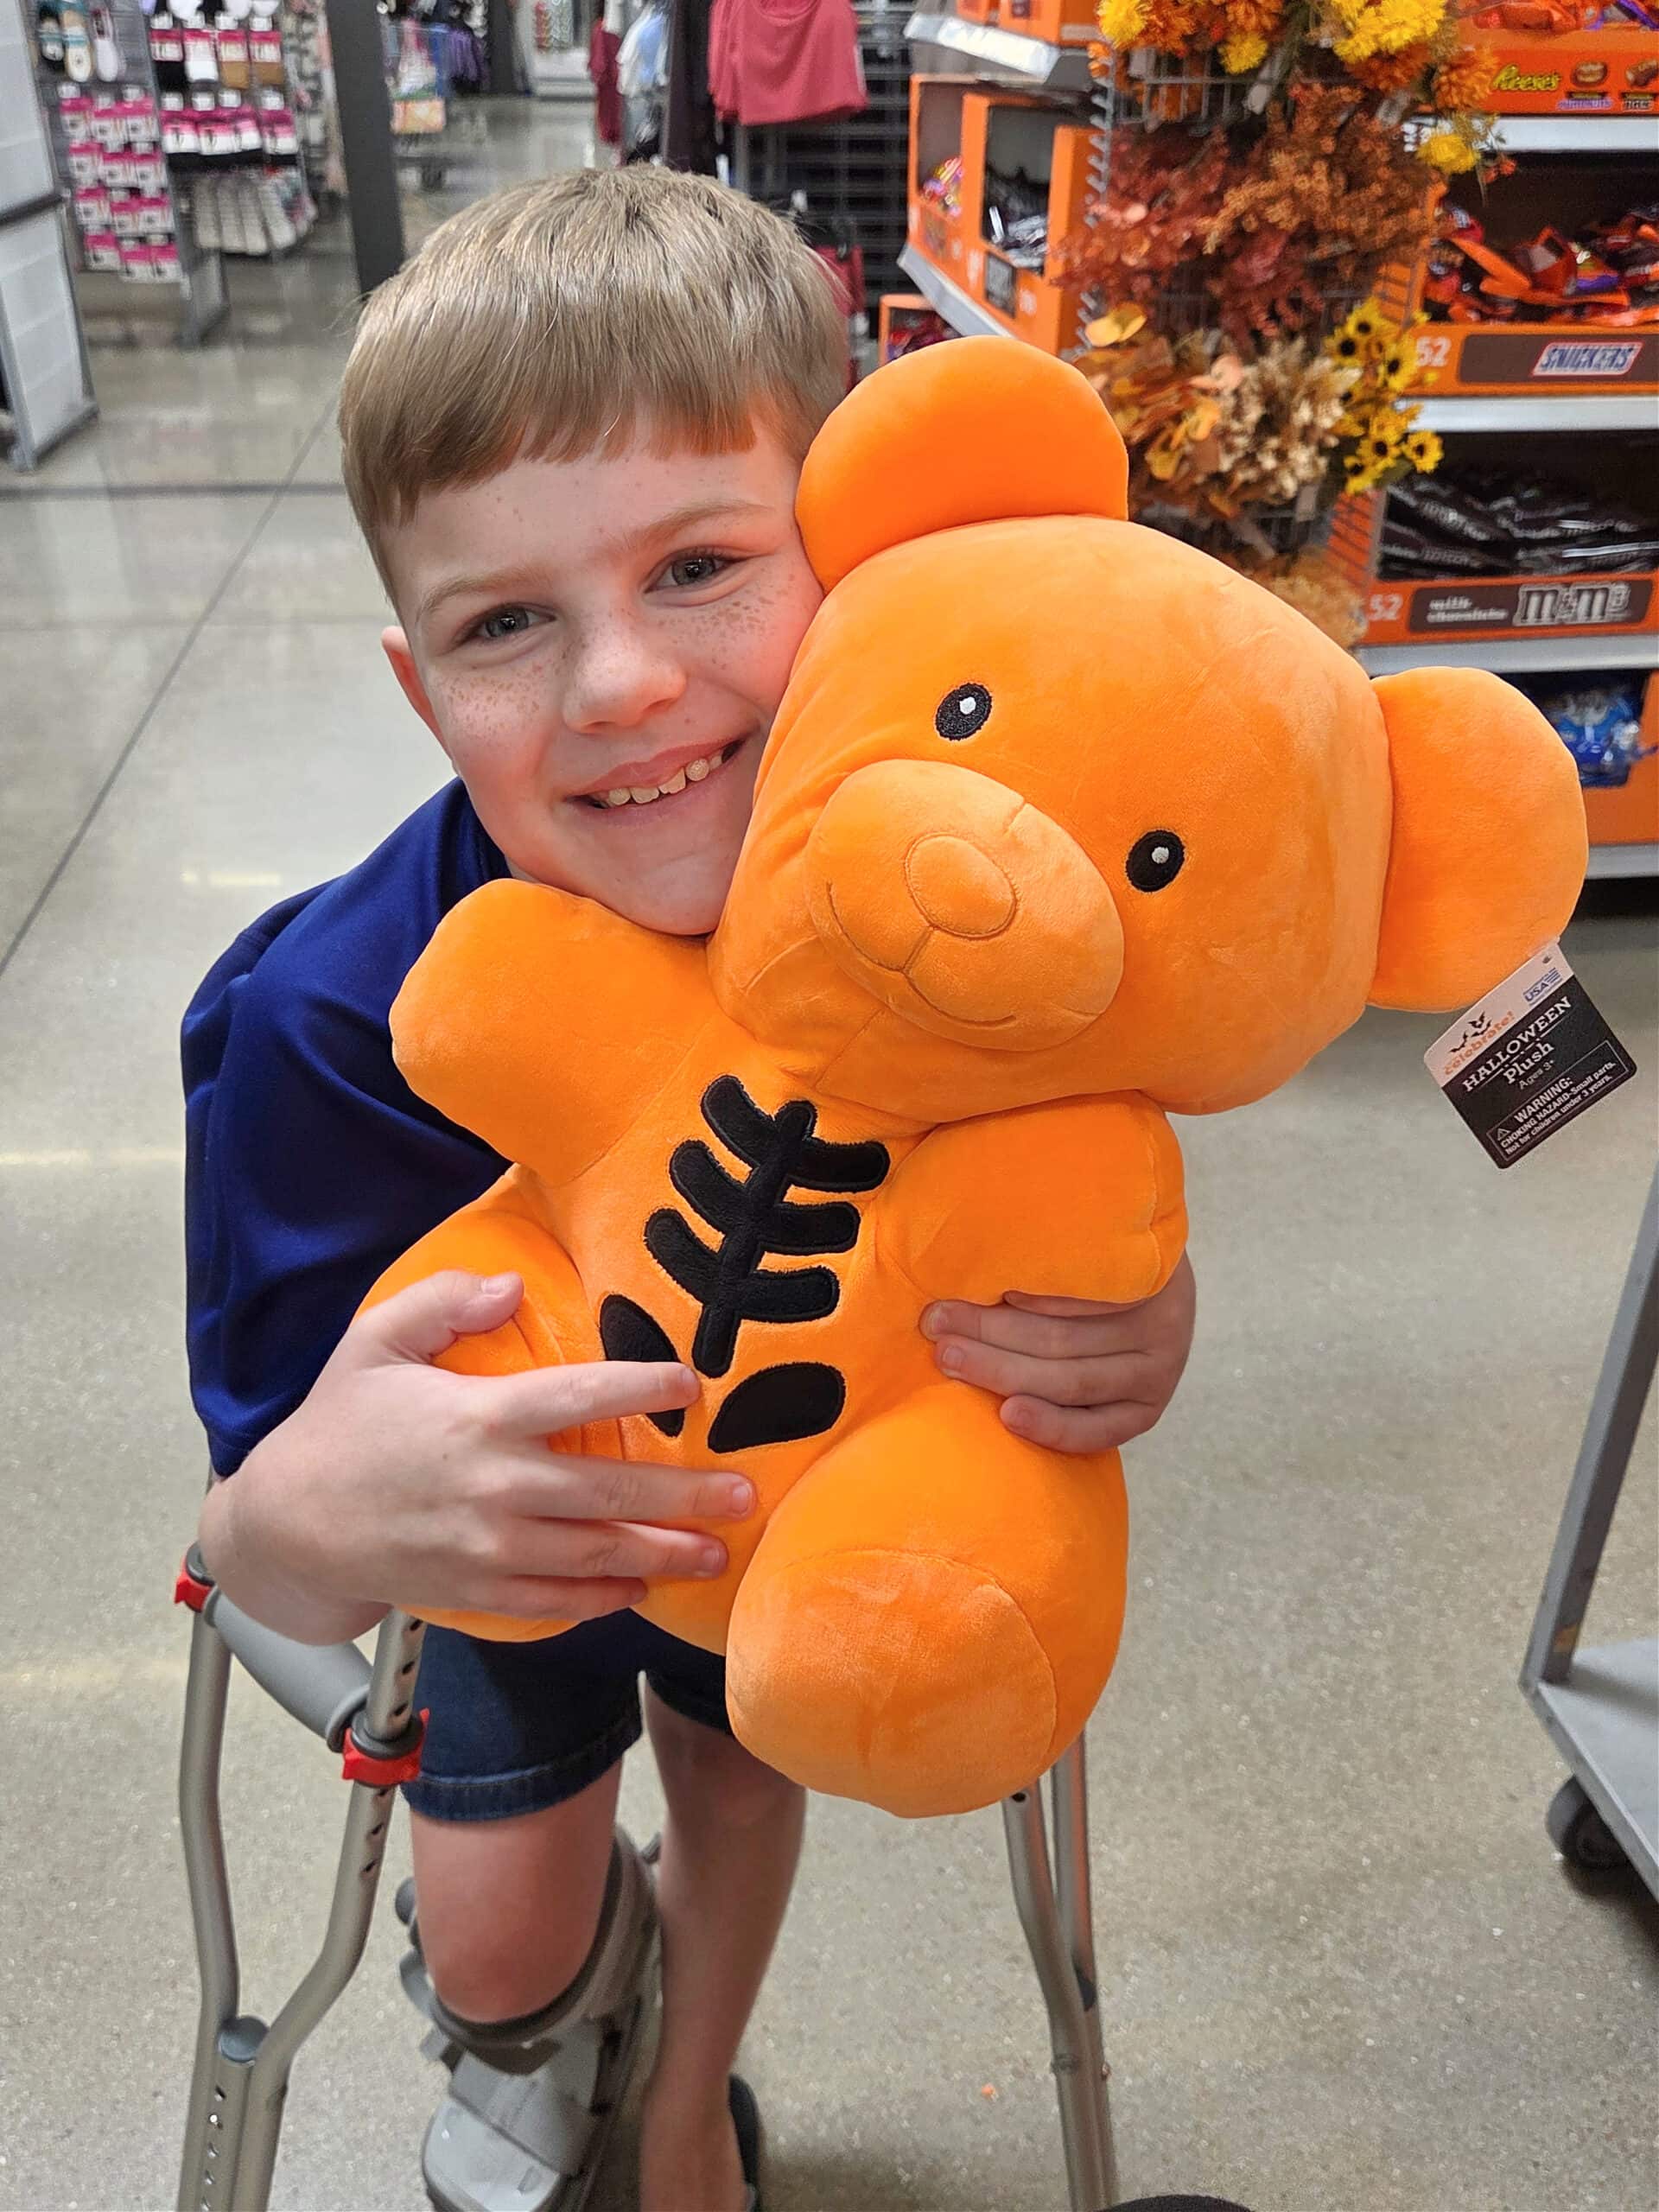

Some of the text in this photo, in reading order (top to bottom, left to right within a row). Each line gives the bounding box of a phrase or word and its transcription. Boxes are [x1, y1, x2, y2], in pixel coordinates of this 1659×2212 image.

[1540, 345, 1636, 372] SNICKERS
[1524, 981, 1549, 1002] USA
[1462, 995, 1572, 1092] HALLOWEEN
[1514, 1077, 1573, 1123] WARNING:
[1500, 1118, 1538, 1148] CHOKING
[1505, 1142, 1521, 1155] Not
[1518, 1133, 1531, 1145] for
[1530, 1110, 1561, 1135] children
[1560, 1096, 1583, 1113] under
